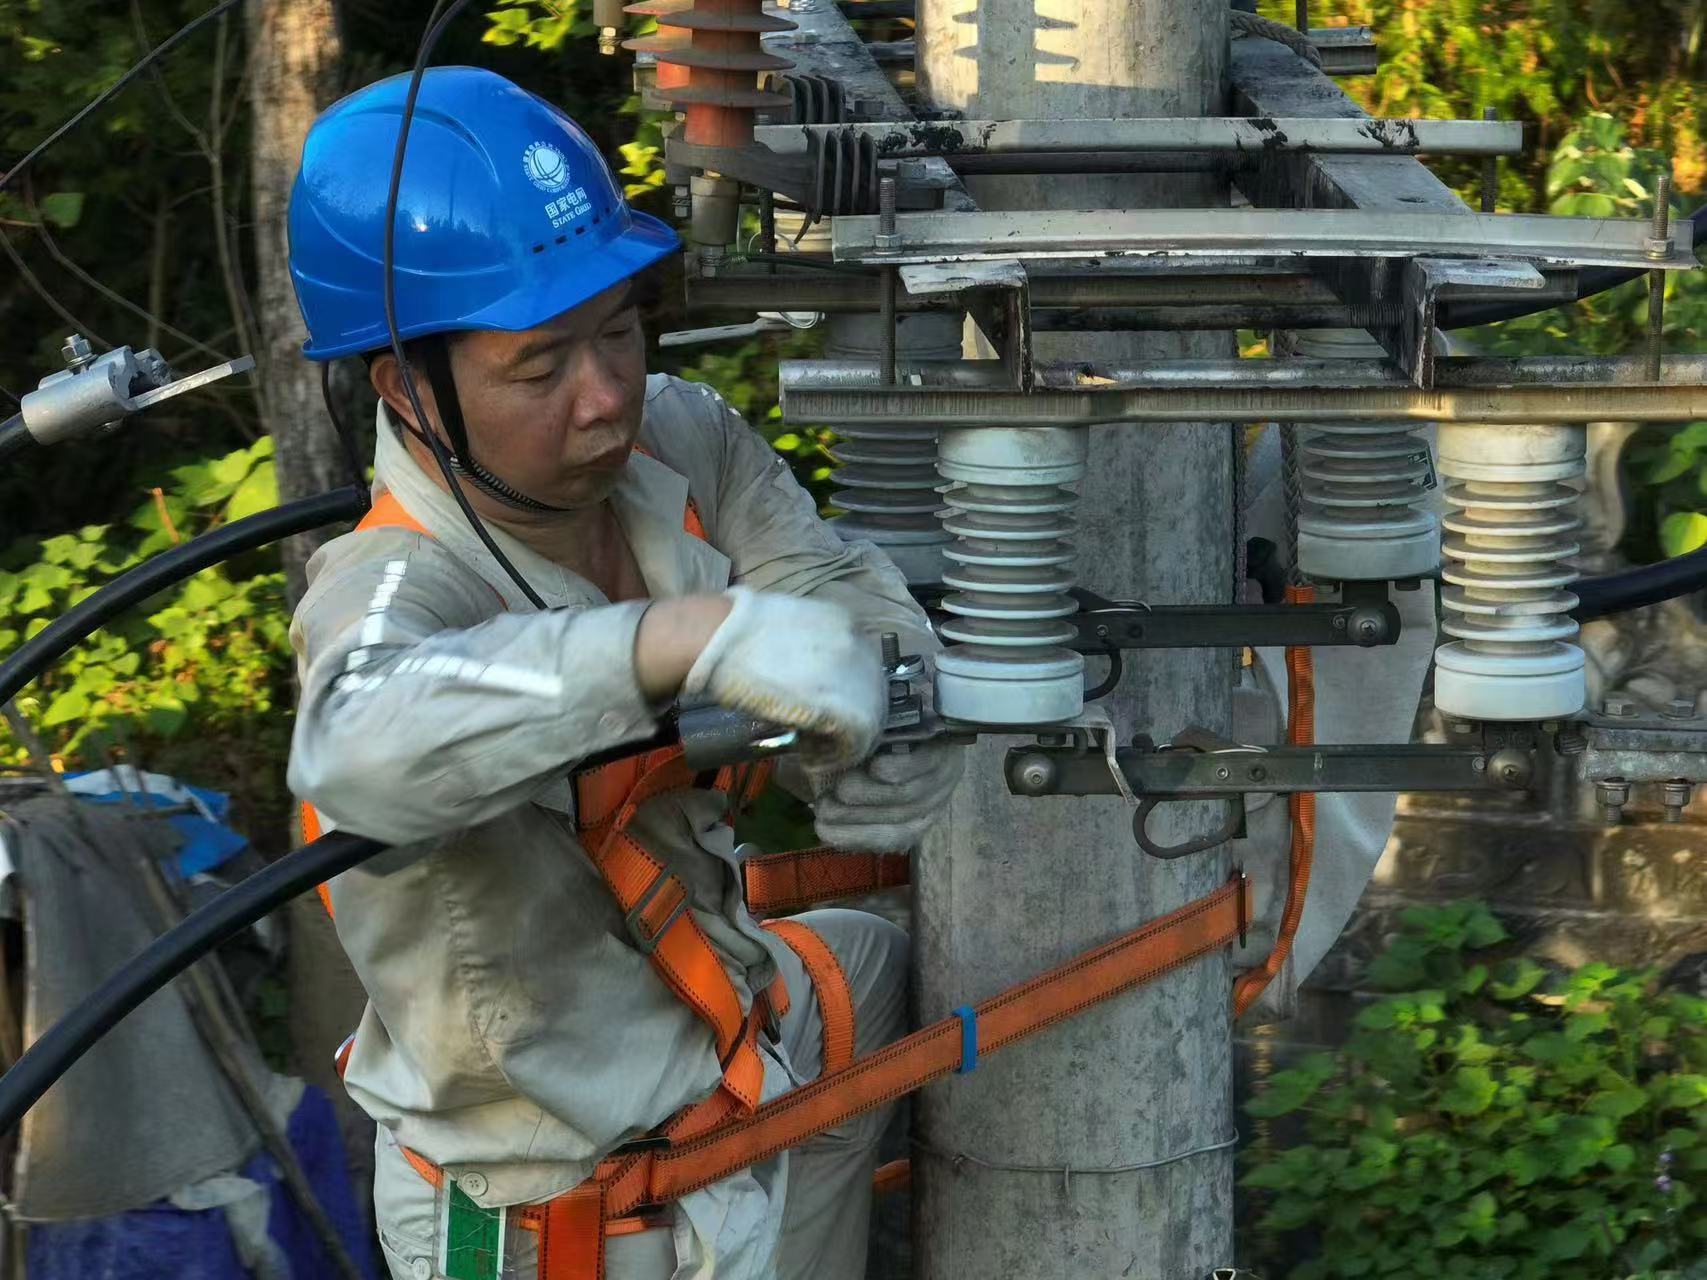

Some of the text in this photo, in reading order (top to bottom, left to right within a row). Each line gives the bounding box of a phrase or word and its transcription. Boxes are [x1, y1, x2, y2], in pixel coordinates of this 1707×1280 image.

[545, 187, 587, 219] 国家电网
[552, 202, 592, 228] STATE GRID
